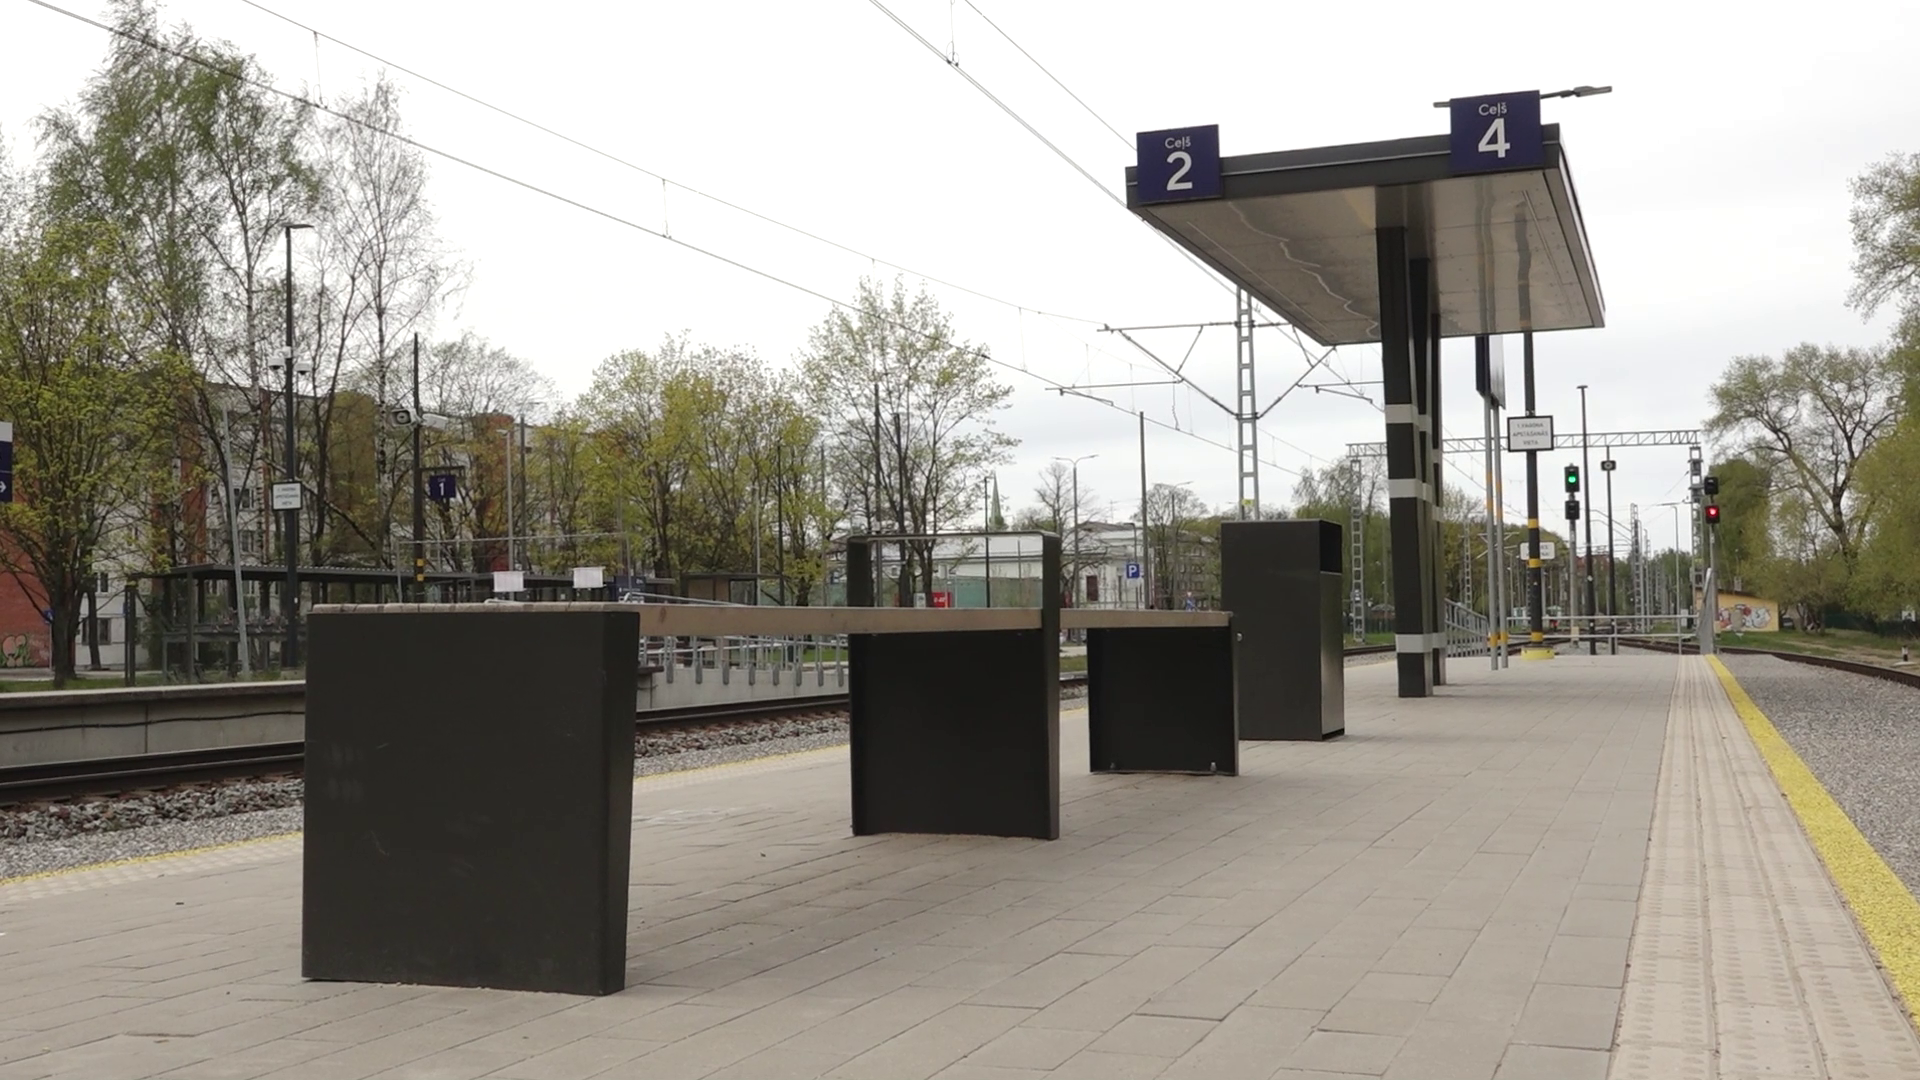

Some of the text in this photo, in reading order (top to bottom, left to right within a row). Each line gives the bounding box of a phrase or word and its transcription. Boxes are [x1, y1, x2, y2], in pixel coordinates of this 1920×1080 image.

[1478, 102, 1507, 117] Ceļš
[1478, 117, 1510, 158] 4
[1166, 151, 1193, 191] 2
[438, 482, 444, 496] 1
[1129, 565, 1137, 577] P
